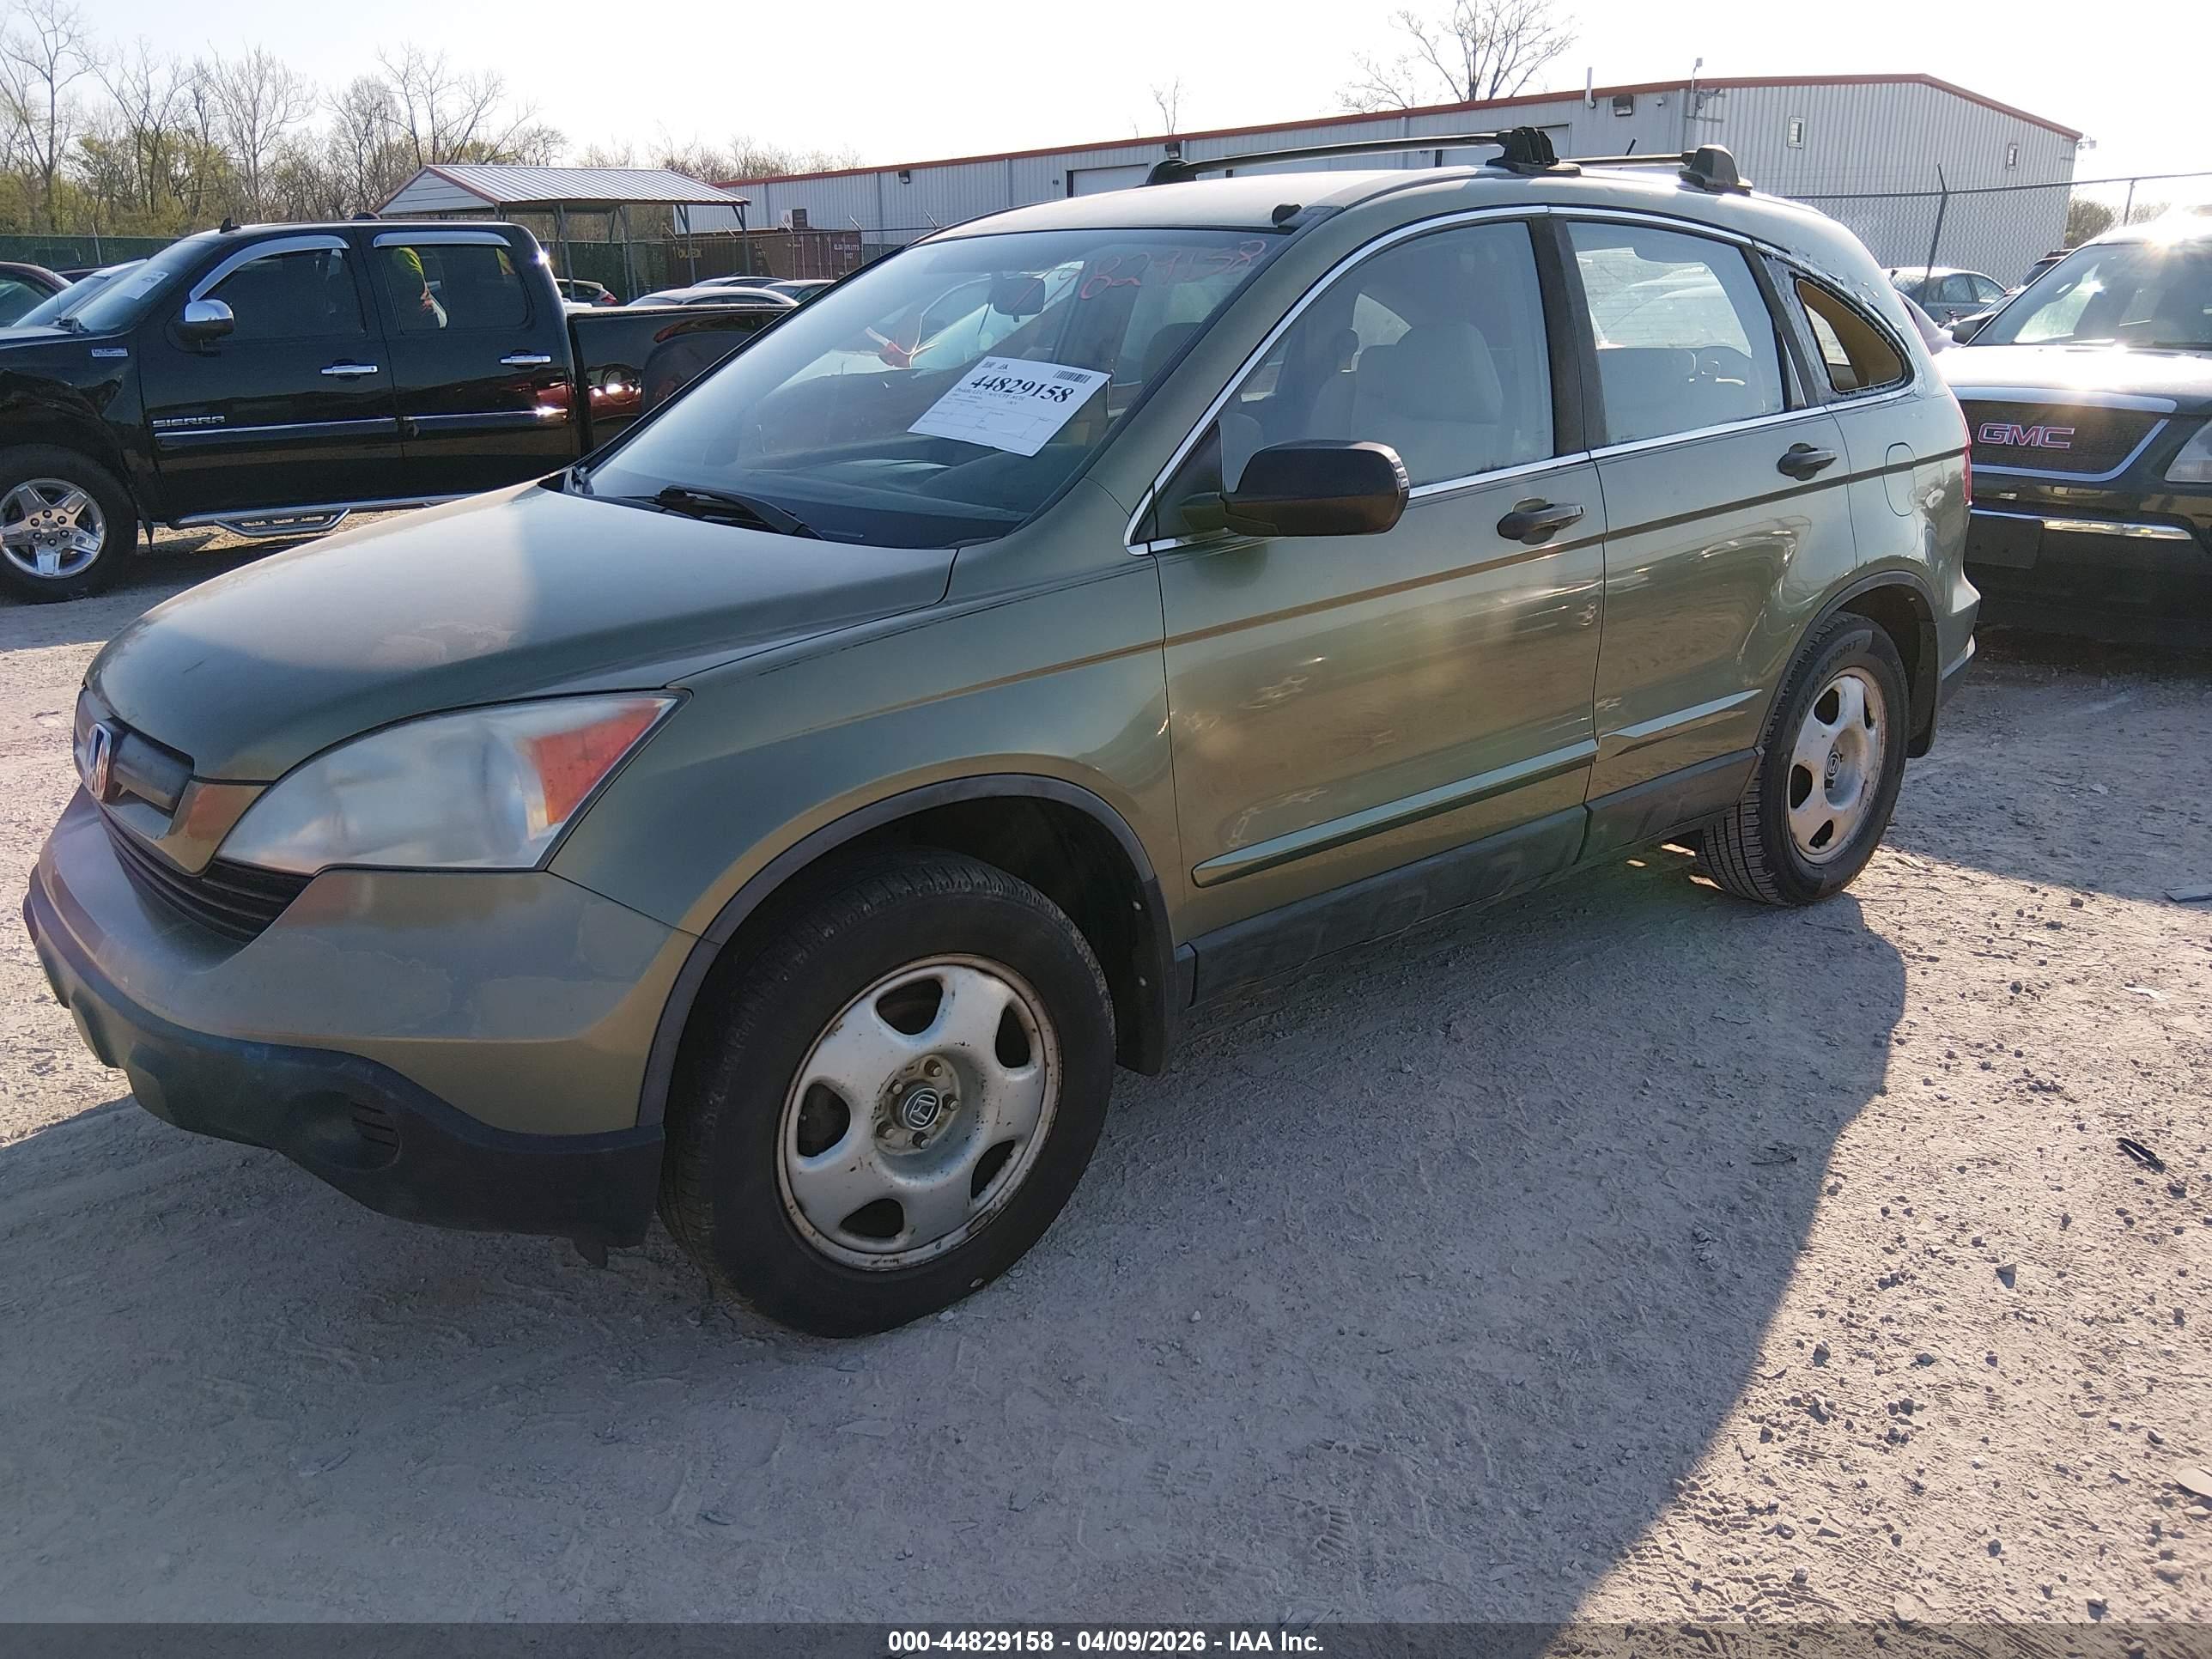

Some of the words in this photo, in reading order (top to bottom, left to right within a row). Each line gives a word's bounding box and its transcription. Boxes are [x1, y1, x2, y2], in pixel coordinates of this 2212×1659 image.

[970, 374, 1074, 404] 44829158
[152, 416, 226, 428] SIERRA
[1978, 422, 2075, 449] GMC
